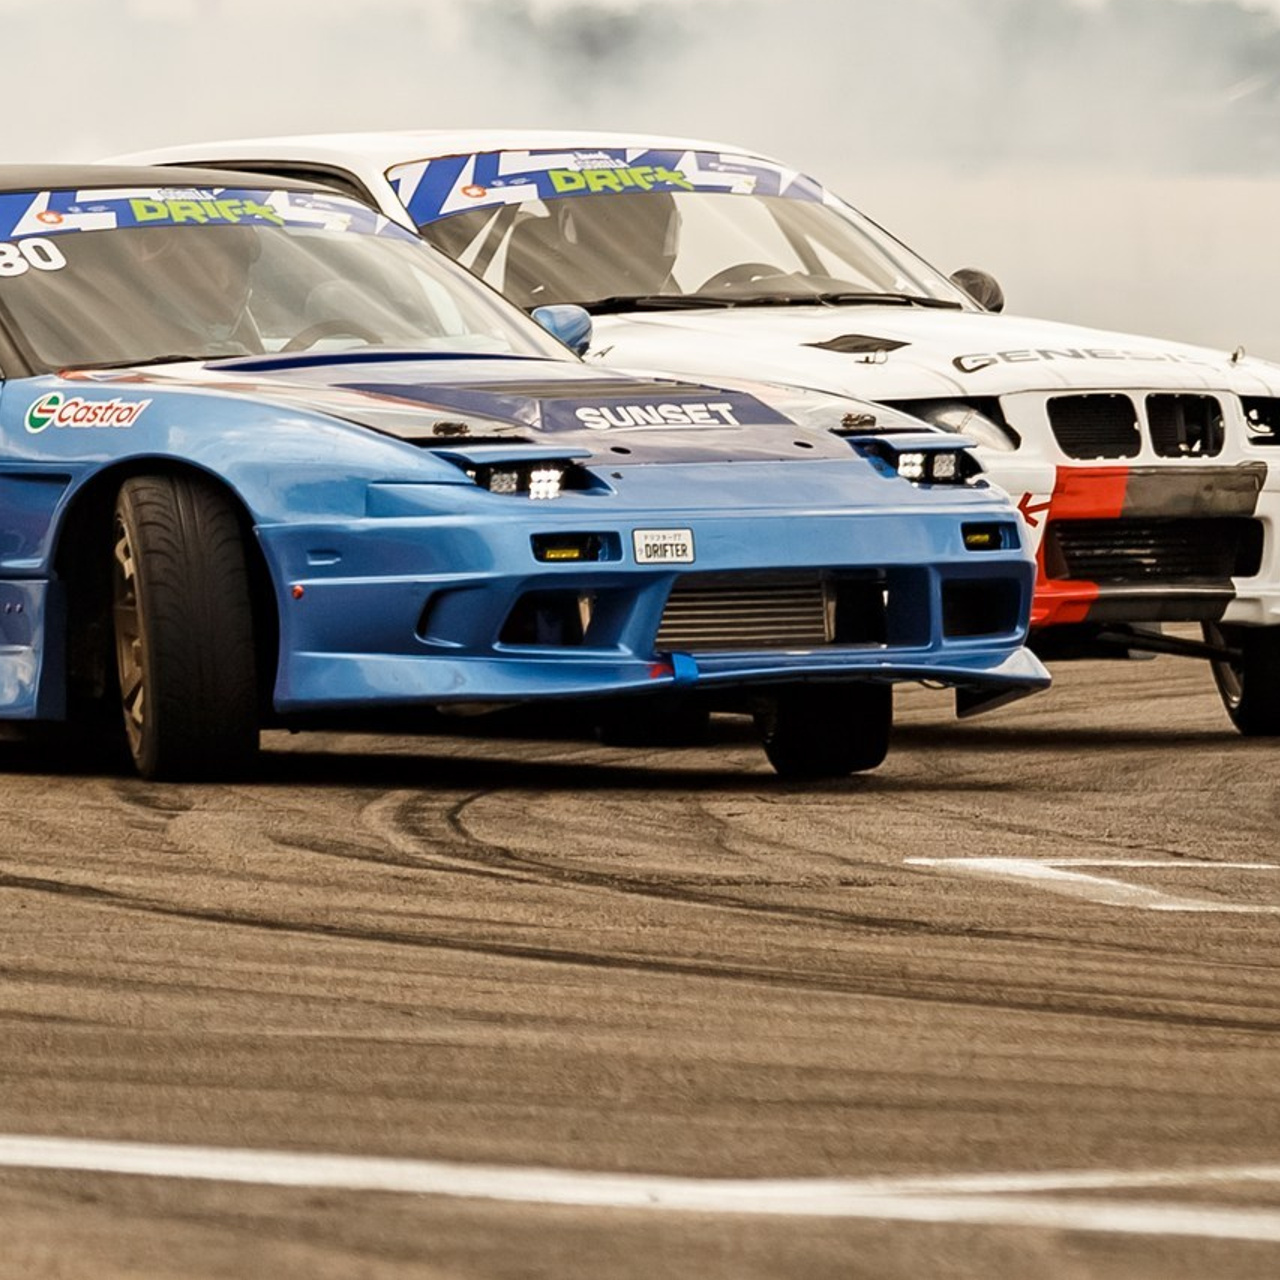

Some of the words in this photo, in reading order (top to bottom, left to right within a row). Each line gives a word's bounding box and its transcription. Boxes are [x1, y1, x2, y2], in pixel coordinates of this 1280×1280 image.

[57, 401, 144, 423] Castrol
[575, 403, 741, 430] SUNSET
[644, 543, 688, 559] DRIFTER
